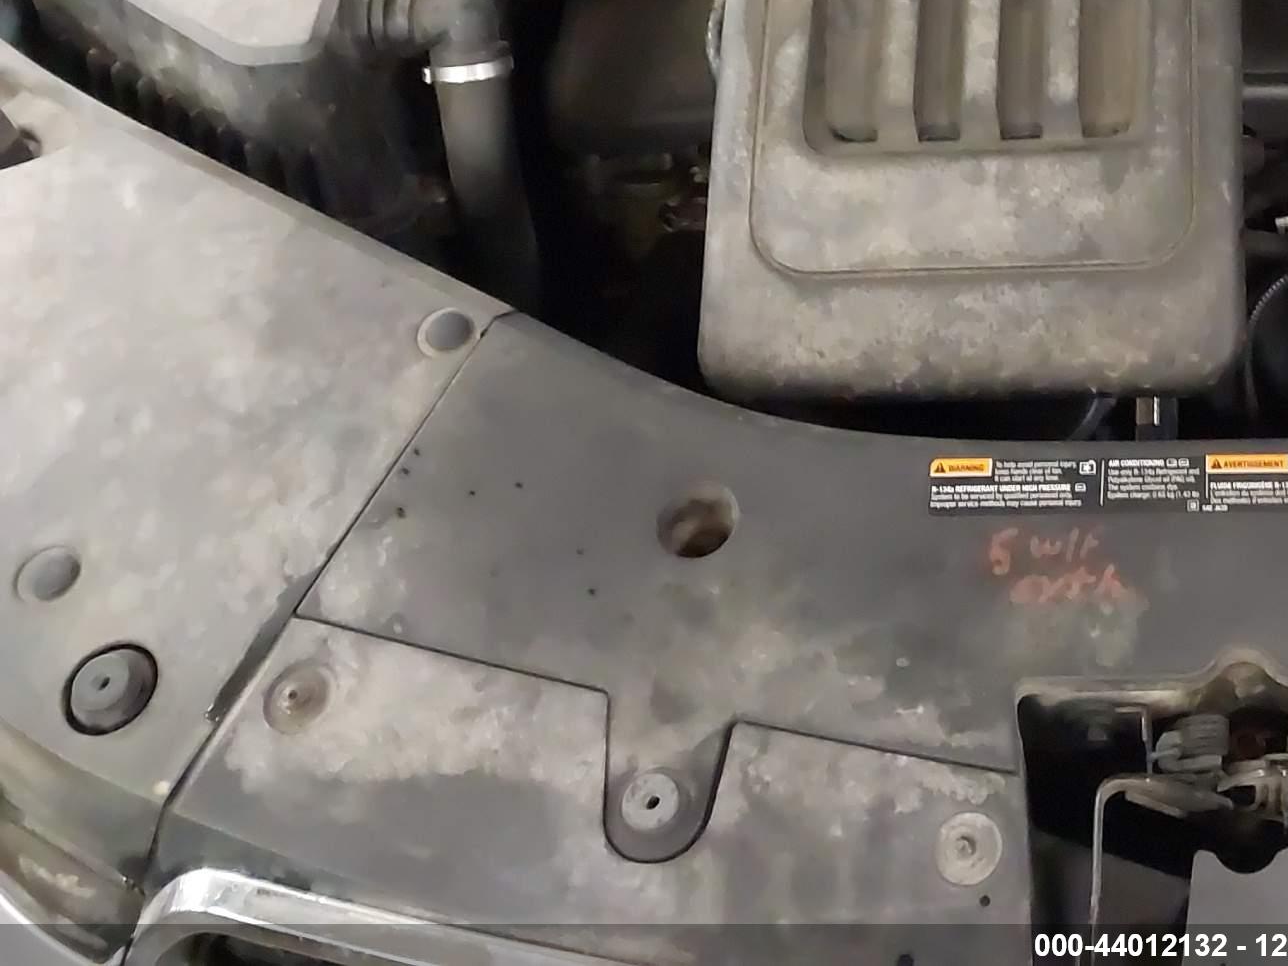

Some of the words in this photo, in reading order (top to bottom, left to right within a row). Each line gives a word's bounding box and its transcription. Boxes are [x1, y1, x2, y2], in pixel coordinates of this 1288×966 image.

[949, 463, 984, 472] WARNING
[955, 484, 997, 492] REFRIGERANT
[1000, 484, 1020, 492] UNDER
[1022, 484, 1037, 492] HIGH
[1039, 484, 1070, 492] PRESSURE
